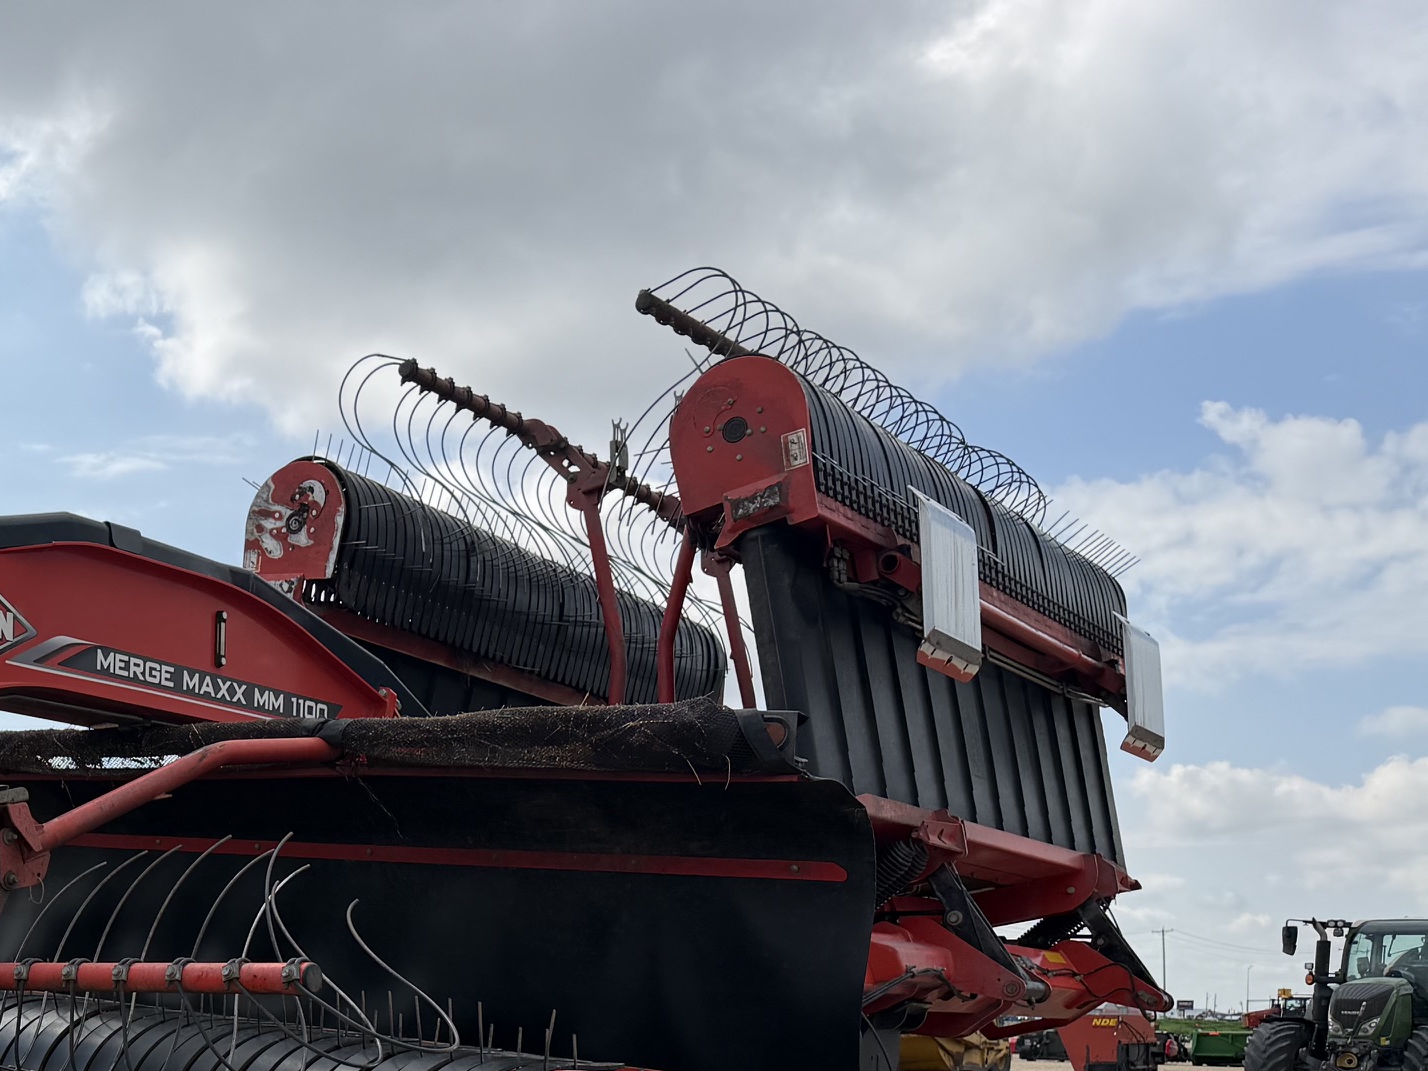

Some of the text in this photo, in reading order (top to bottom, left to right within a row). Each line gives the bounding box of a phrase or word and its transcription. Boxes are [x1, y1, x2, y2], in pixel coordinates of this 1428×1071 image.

[96, 648, 328, 720] MERGE MAXX MM 1100
[1092, 1018, 1118, 1027] NDE
